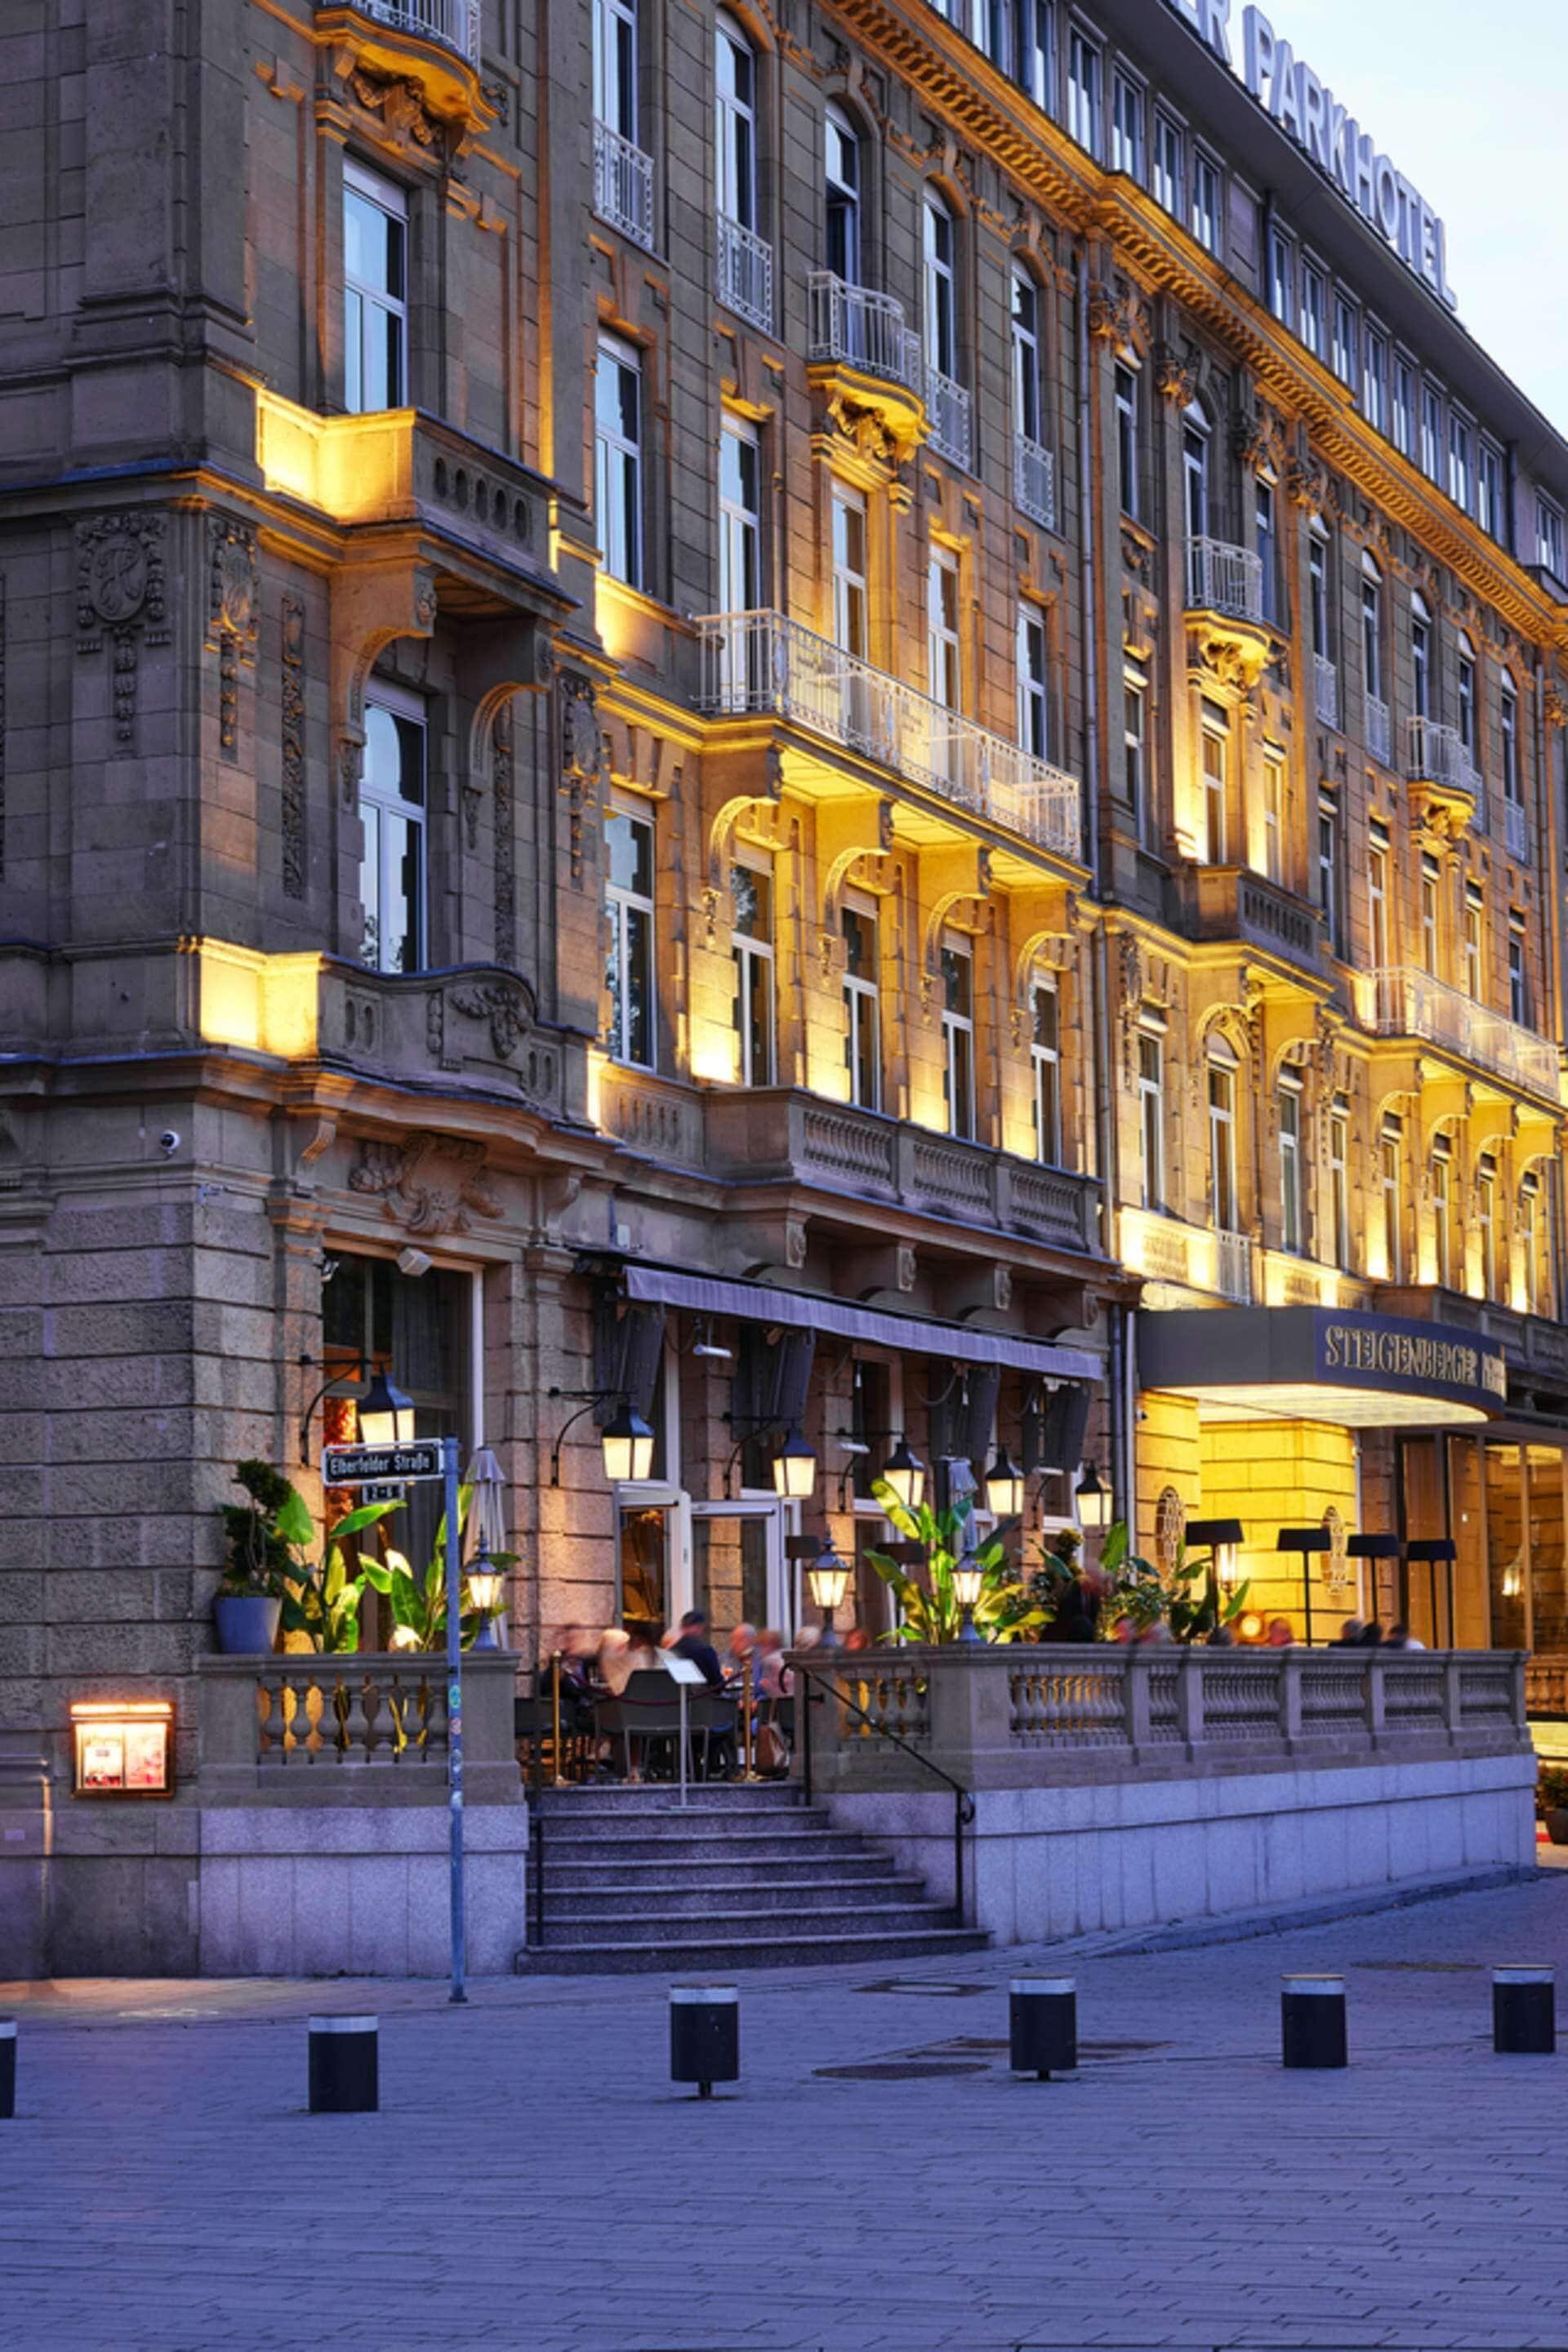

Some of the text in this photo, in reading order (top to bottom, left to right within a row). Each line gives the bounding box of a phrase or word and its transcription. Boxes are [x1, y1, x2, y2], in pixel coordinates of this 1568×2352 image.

[1169, 0, 1457, 310] R PARKHOTEL
[1325, 1325, 1477, 1385] STEIGENBERGER
[330, 1452, 430, 1476] Elberfelder Straße
